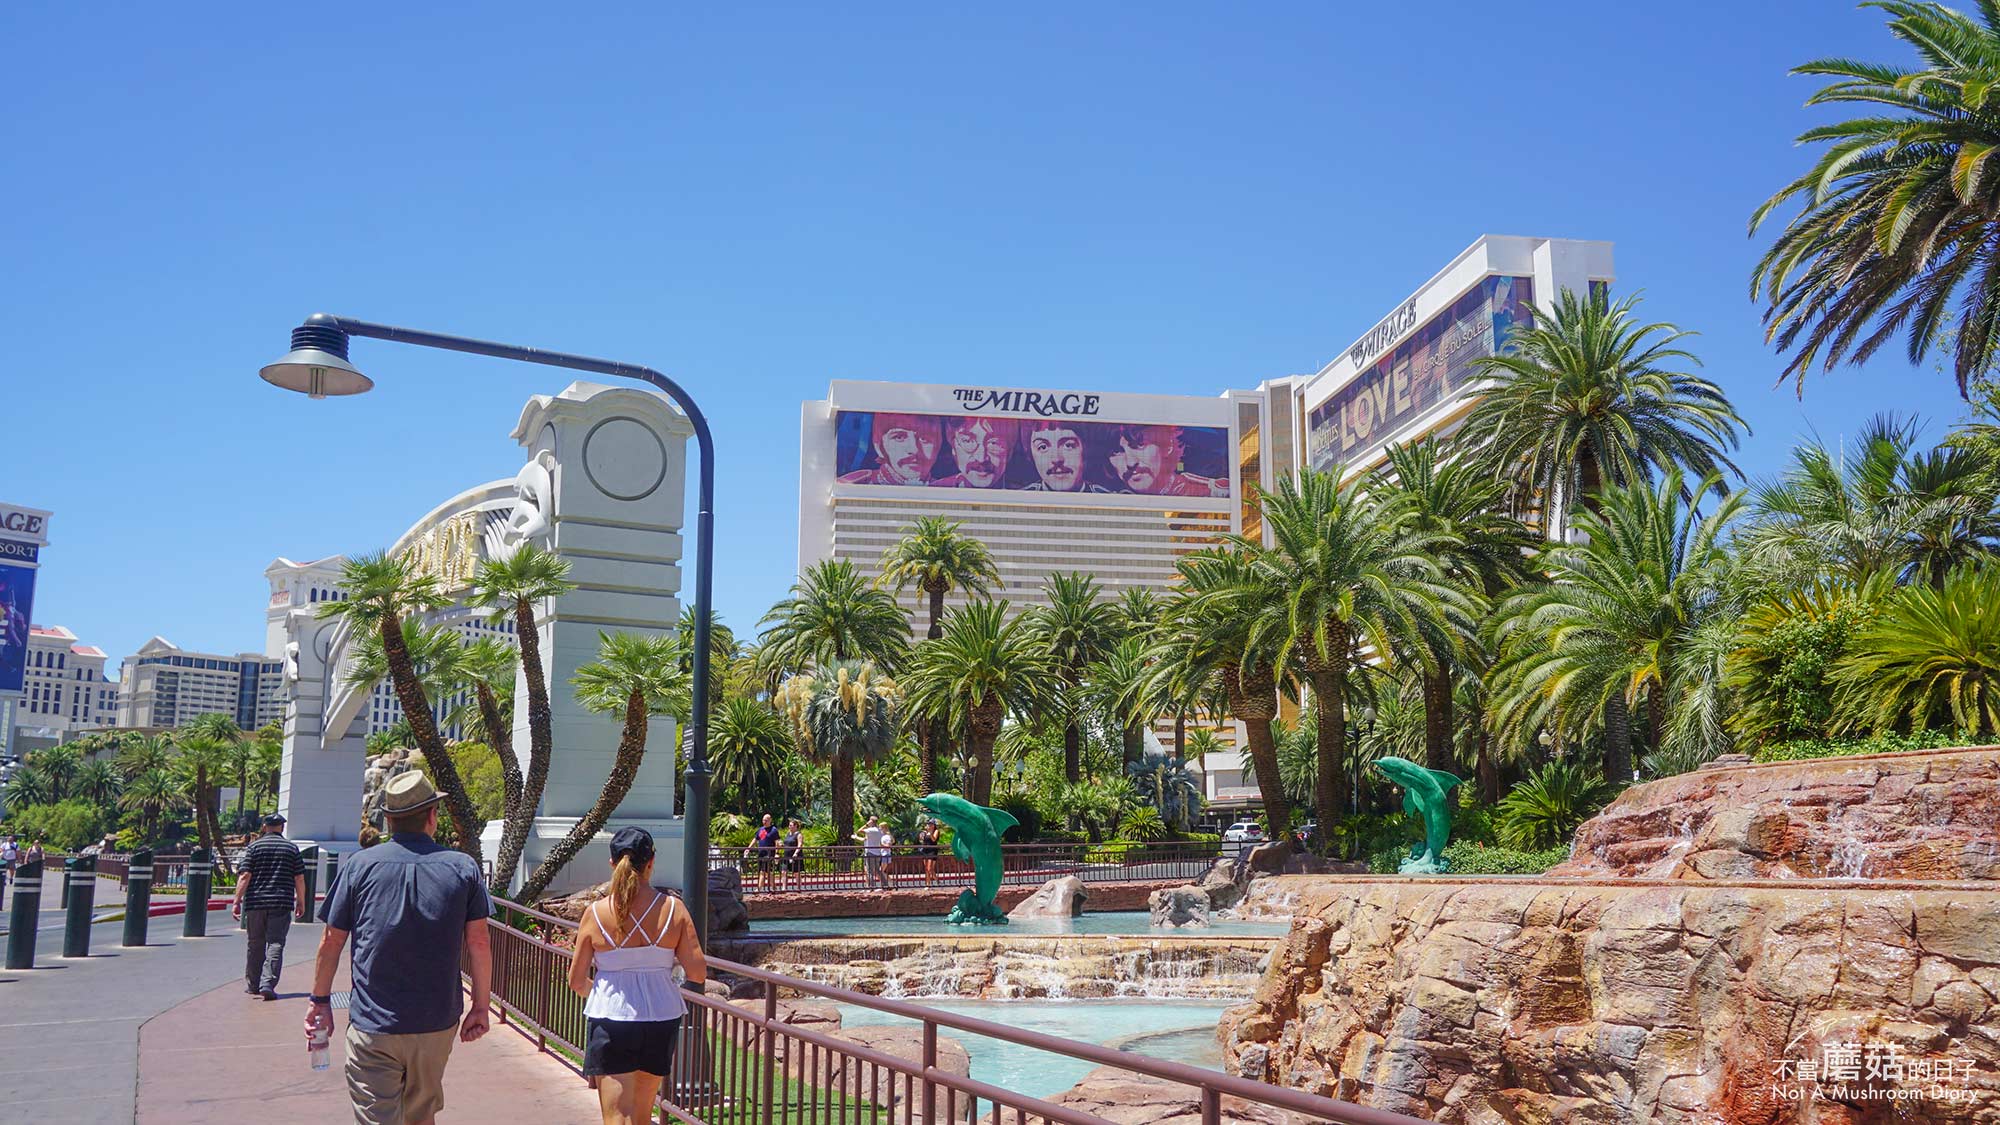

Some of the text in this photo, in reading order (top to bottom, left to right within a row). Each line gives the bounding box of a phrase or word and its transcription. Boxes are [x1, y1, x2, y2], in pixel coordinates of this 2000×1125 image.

[1355, 298, 1417, 370] MIRAGE
[953, 388, 1100, 416] THE MIRAGE
[1340, 354, 1412, 452] LOVE
